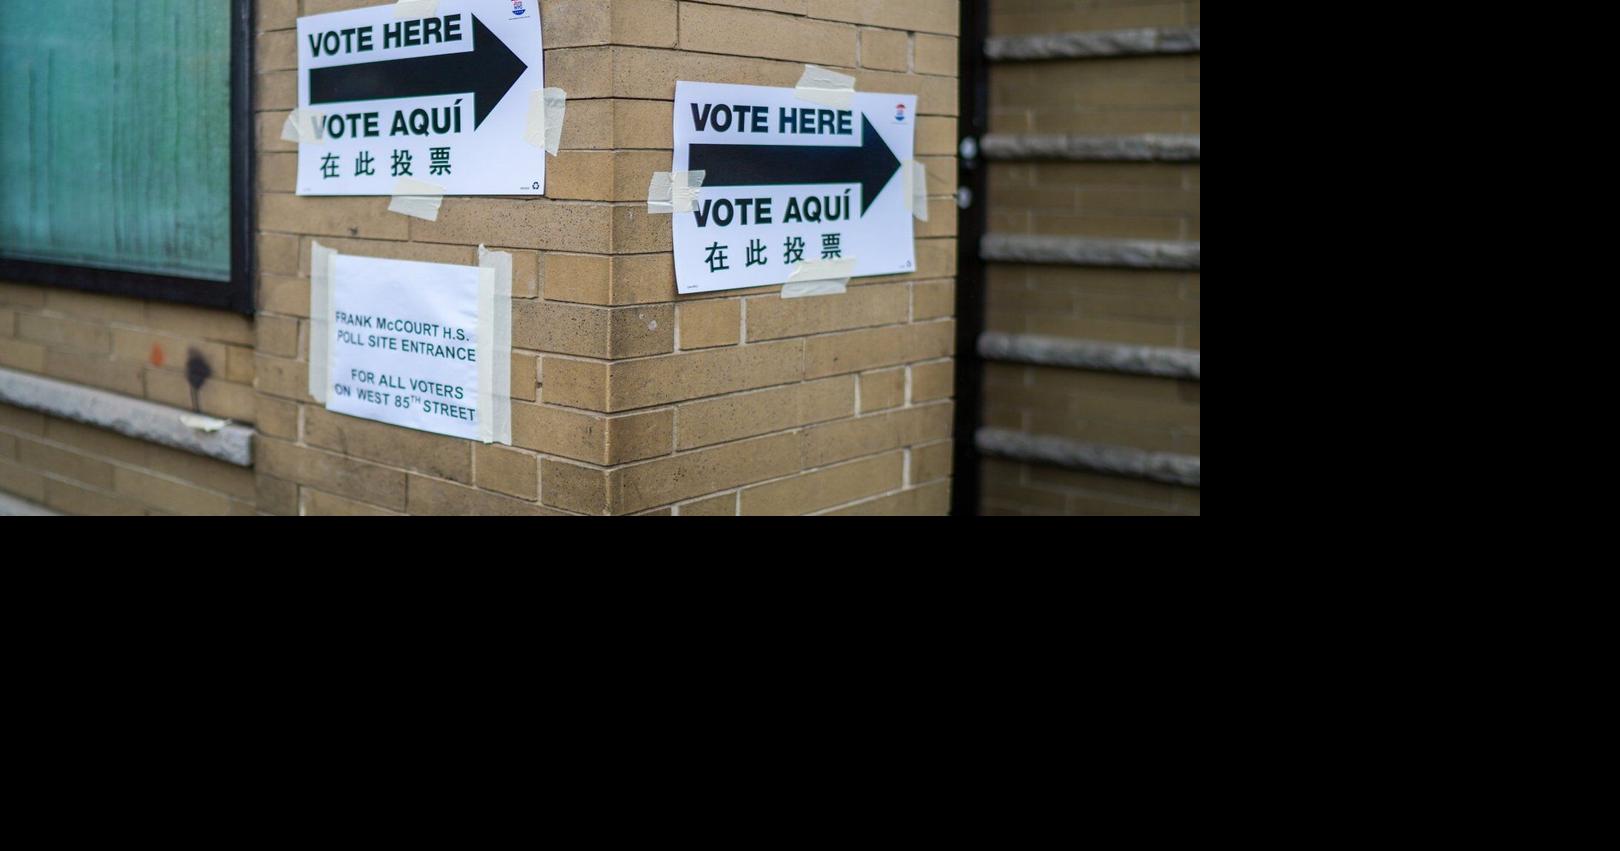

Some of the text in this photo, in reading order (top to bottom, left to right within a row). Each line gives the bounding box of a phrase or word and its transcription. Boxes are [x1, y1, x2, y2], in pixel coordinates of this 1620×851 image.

[308, 13, 462, 58] VOTE HERE
[310, 98, 463, 140] VOTE AQUÍ
[691, 102, 853, 136] VOTE HERE
[320, 146, 452, 179] 在此投票
[691, 188, 852, 228] VOTE AQUÍ
[704, 232, 842, 273] 在此投票
[335, 311, 470, 342] FRANK McCOURT H.S.
[337, 330, 476, 362] POLL SITE ENTRANCE
[334, 383, 476, 421] ON WEST 85TH STREET
[351, 368, 464, 400] FOR ALL VOTERS
